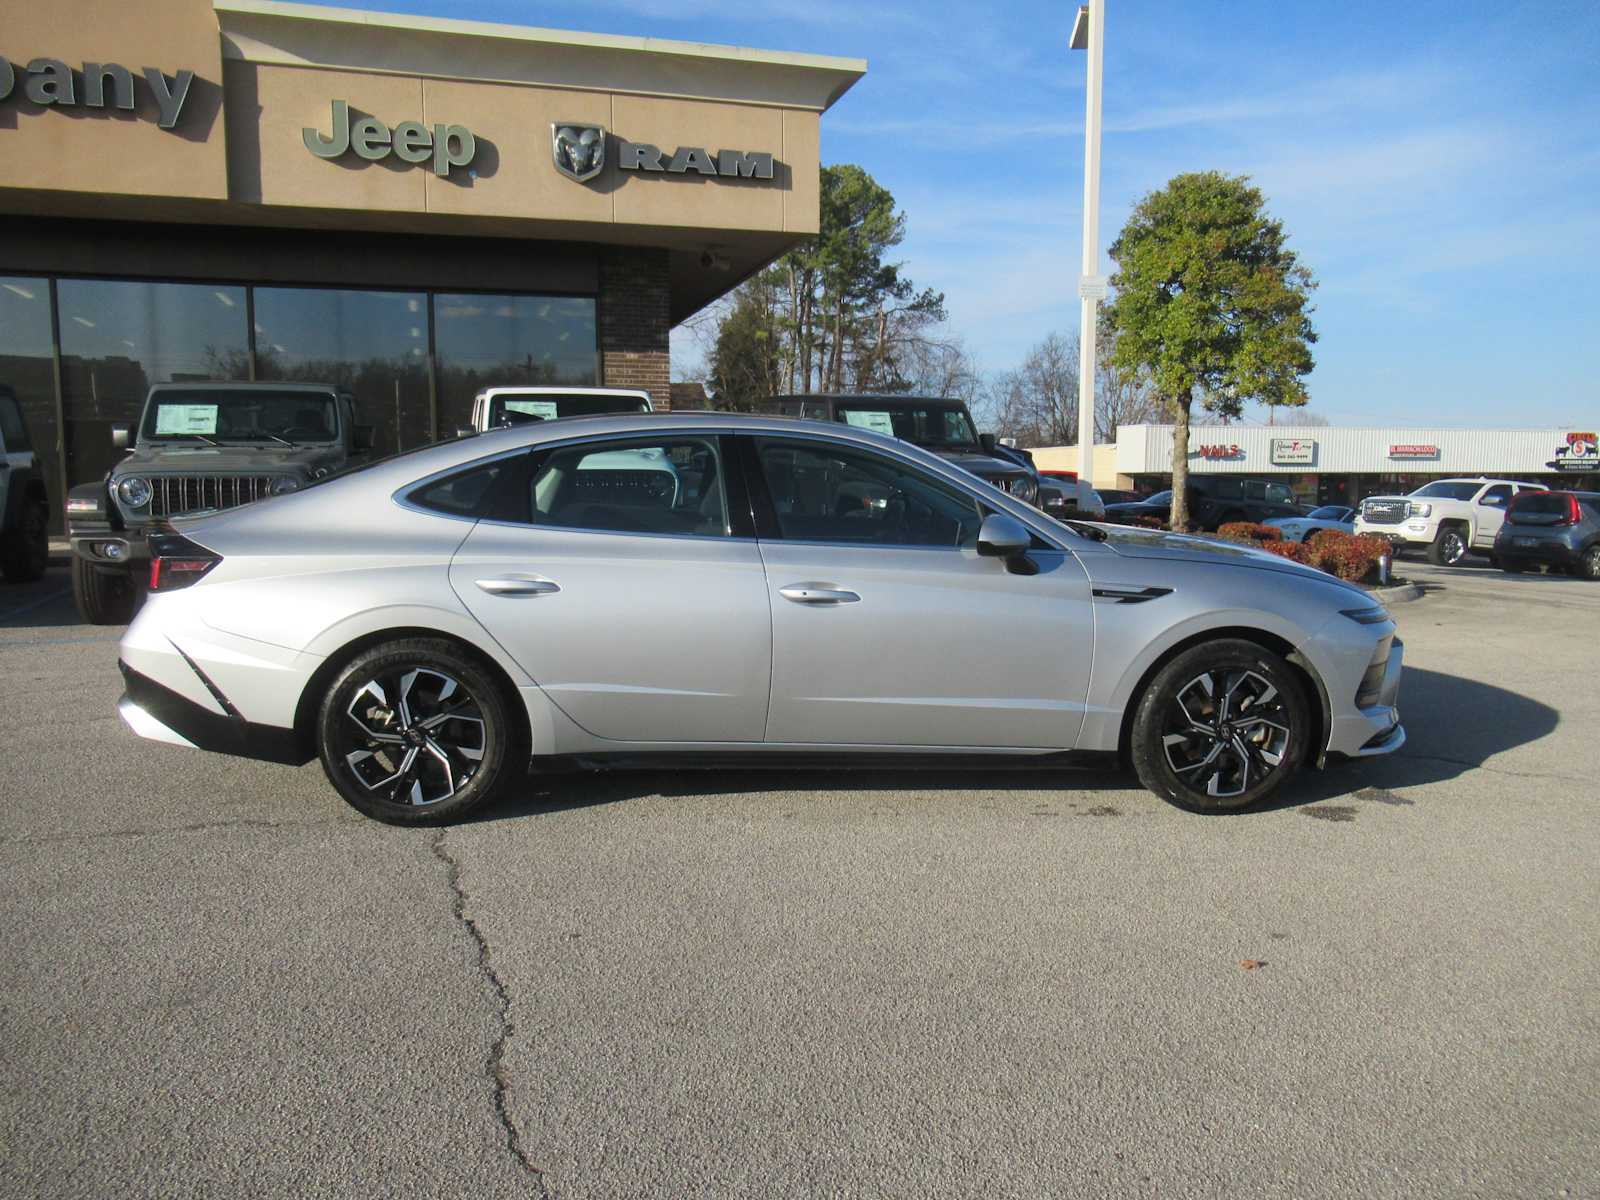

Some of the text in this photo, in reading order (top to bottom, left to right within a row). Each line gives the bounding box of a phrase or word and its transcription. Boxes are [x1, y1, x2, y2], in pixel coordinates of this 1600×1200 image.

[302, 99, 476, 176] Jeep
[619, 143, 774, 179] RAM
[1199, 444, 1239, 457] NAILS
[1574, 441, 1583, 454] S
